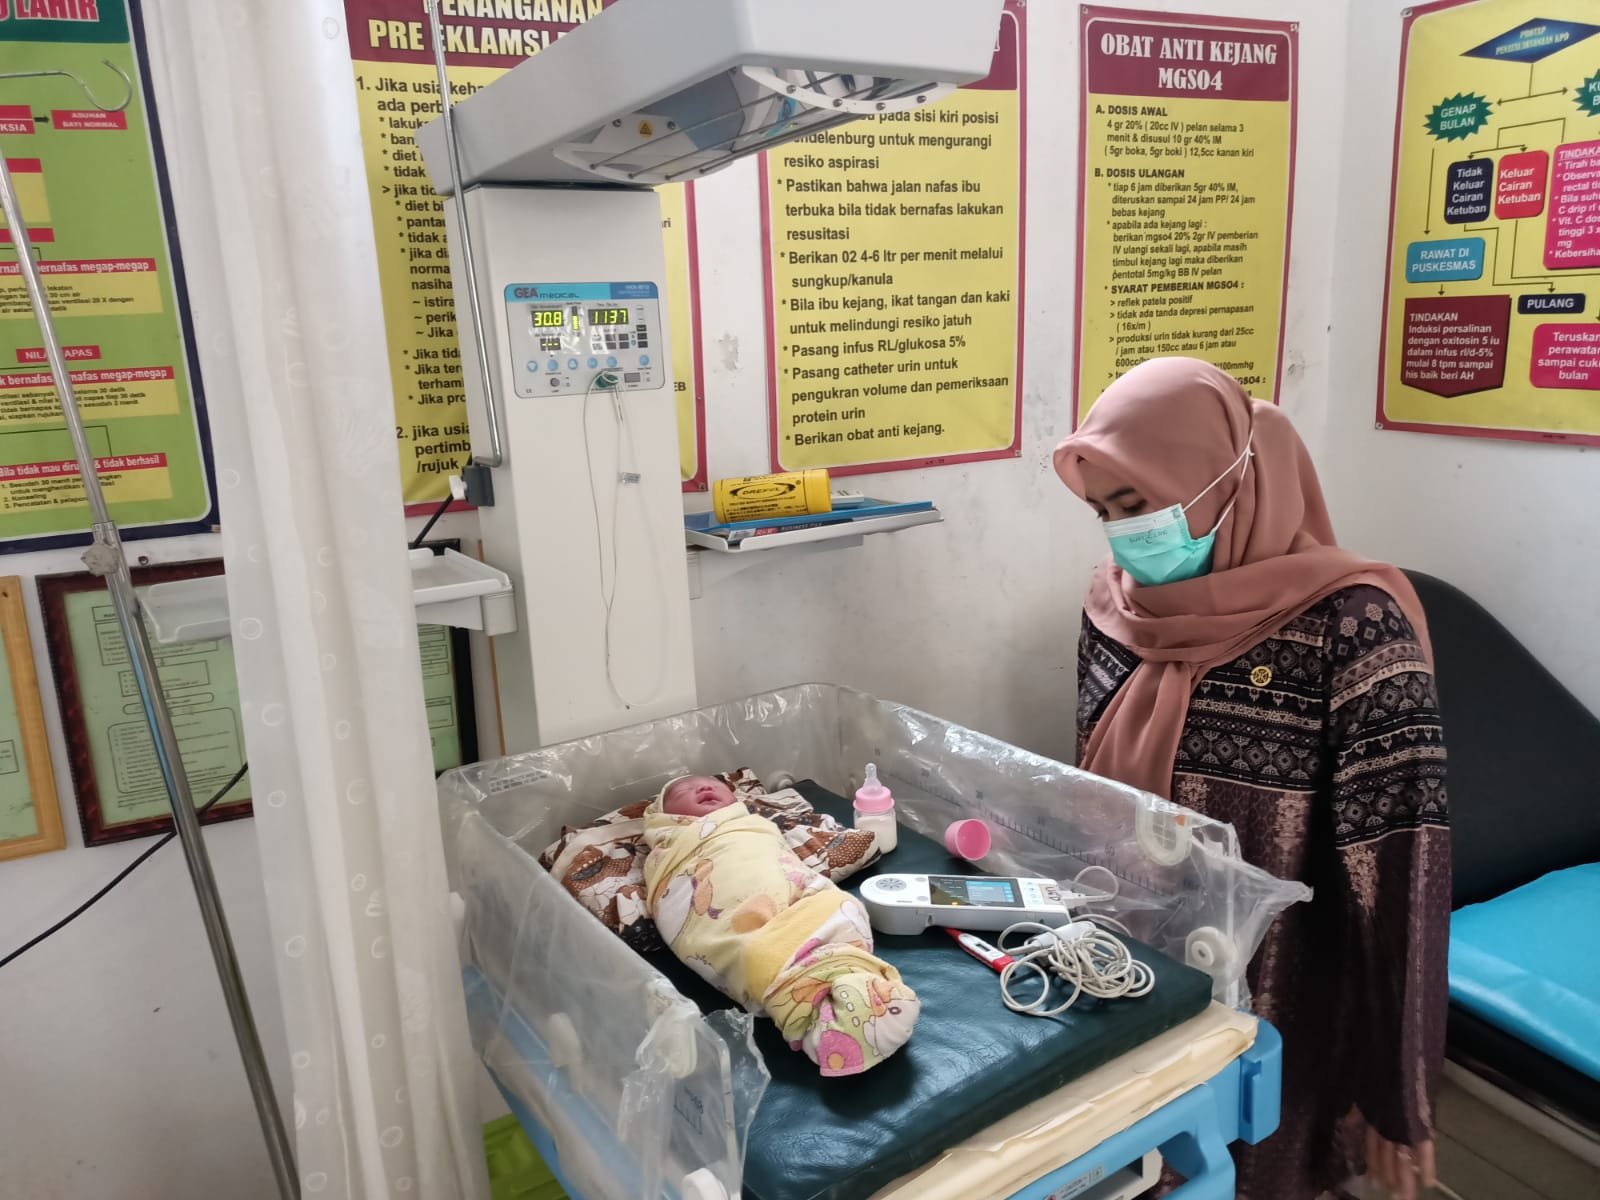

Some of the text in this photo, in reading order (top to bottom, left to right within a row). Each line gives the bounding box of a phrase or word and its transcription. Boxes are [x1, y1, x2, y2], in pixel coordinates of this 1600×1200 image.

[369, 19, 424, 50] PRE
[1101, 32, 1277, 66] OBAT ANTI KEJANG
[356, 75, 370, 91] 1.
[376, 78, 408, 93] Jika
[377, 98, 405, 113] ada
[1096, 105, 1168, 117] A. DOSIS AWAL
[1441, 103, 1477, 118] GENAP
[879, 111, 910, 126] pada
[914, 110, 935, 122] sisi
[939, 110, 958, 123] kiri
[962, 111, 999, 126] posisi
[1439, 116, 1475, 131] BULAN
[1186, 122, 1237, 133] pelan selama
[879, 133, 992, 148] untuk mengurangi
[1107, 132, 1170, 144] menit disusul
[392, 149, 416, 161] diet
[784, 155, 879, 172] resiko aspirasi
[394, 166, 426, 177] tidak
[1094, 168, 1185, 178] B. DOSIS ULANGAN
[1457, 166, 1483, 177] Tidak
[1500, 167, 1535, 179] Keluar
[394, 184, 417, 198] jika
[786, 179, 980, 196] Pastikan bahwa jalan nafas ibu
[1155, 182, 1225, 192] diberikan 40%
[1453, 180, 1485, 191] Keluar
[1499, 180, 1533, 192] Cairan
[1452, 192, 1483, 203] Cairan
[1498, 192, 1541, 205] Ketuban
[405, 200, 429, 211] diet
[785, 202, 1004, 217] terbuka bila tidak bernafas lakukan
[1447, 204, 1487, 216] Ketuban
[1138, 207, 1165, 219] kejang
[408, 232, 439, 243] tidak
[787, 226, 850, 240] resusitasi
[1174, 231, 1191, 241] 20%
[1217, 231, 1258, 242] pemberian
[409, 248, 432, 261] jika
[789, 251, 838, 265] Berikan
[860, 250, 880, 262] 4-6
[883, 250, 896, 262] ltr
[900, 250, 920, 265] per
[923, 248, 957, 261] menit
[960, 247, 1003, 260] melalui
[1420, 248, 1470, 260] RAWAT DI
[39, 261, 149, 273] ernafas megap-megap
[1113, 256, 1167, 268] timbul kejang
[1412, 260, 1476, 273] PUSKESMAS
[410, 264, 450, 274] norma
[792, 273, 893, 290] sungkup/kanula
[514, 287, 538, 299] GEA
[1111, 284, 1148, 295] SYARAT
[1151, 282, 1204, 293] PEMBERIAN
[790, 290, 1010, 312] Bila ibu kejang, ikat tangan dan kaki
[1527, 298, 1574, 309] PULANG
[593, 309, 627, 324] 1137
[1180, 306, 1207, 318] depresi
[1409, 312, 1458, 322] TINDAKAN
[790, 314, 972, 335] untuk melindungi resiko jatuh
[1409, 324, 1492, 335] Induksi persalinan
[427, 327, 453, 338] Jika
[792, 335, 966, 358] Pasang infus RL/glukosa 5%
[1408, 336, 1440, 347] dengan
[1442, 336, 1479, 345] oxitosin
[1482, 336, 1488, 345] 5
[413, 349, 439, 360] Jika
[1407, 347, 1457, 357] dalam infus
[1406, 359, 1493, 370] mulai tpm sampai
[1537, 357, 1576, 368] sampai
[414, 364, 440, 375] Jika
[792, 358, 958, 382] Pasang catheter urin untuk
[1405, 370, 1474, 380] his baik beri AH
[1559, 370, 1589, 381] bulan
[8, 369, 166, 385] bernafas megap-megap
[792, 376, 1009, 404] pengukran volume dan pemeriksaan
[418, 394, 443, 405] Jika
[792, 408, 866, 427] protein urin
[396, 427, 408, 439] 2.
[412, 424, 439, 441] jika
[794, 422, 945, 446] Berikan obat anti kejang.
[17, 455, 160, 475] tidak mau tidak berhasil
[417, 458, 459, 474] /rujuk
